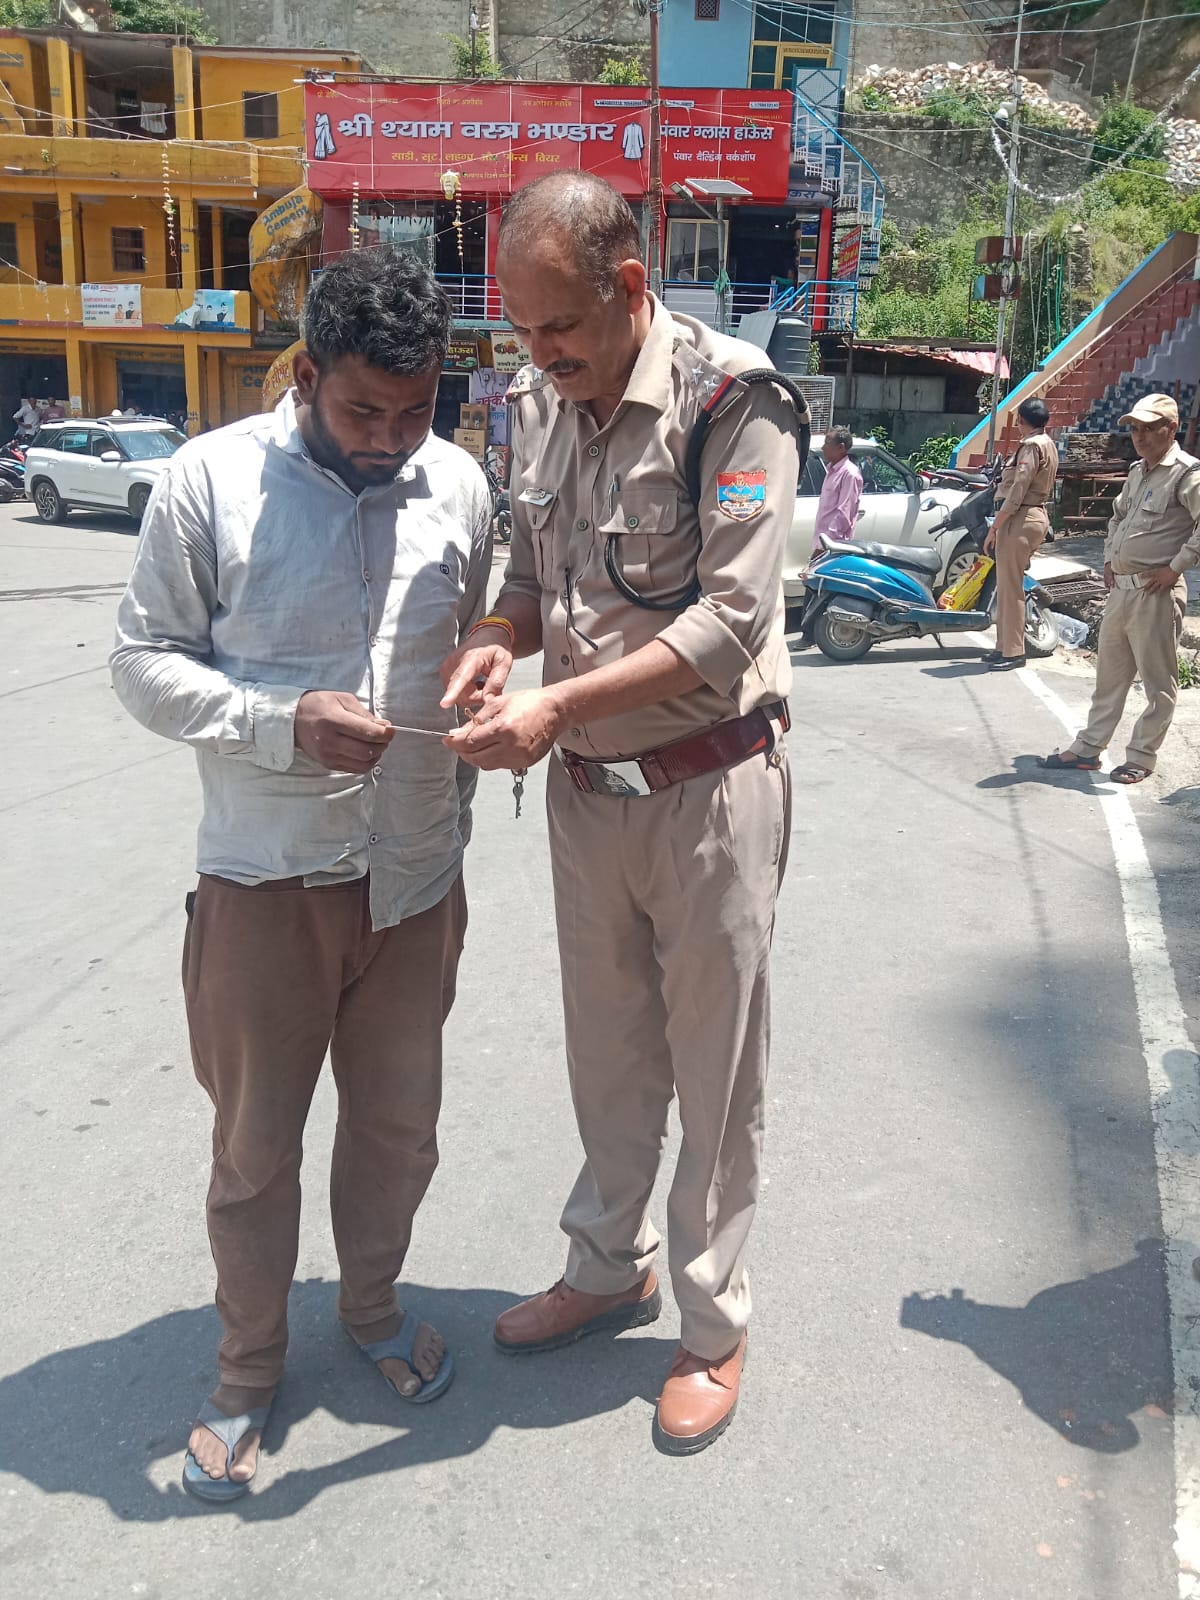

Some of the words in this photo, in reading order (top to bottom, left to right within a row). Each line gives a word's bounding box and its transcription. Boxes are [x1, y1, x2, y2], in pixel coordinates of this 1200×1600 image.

[336, 113, 375, 137] श्री
[381, 120, 453, 138] श्याम
[460, 121, 521, 139] वस्त्र
[527, 122, 617, 142] भण्डार
[693, 125, 732, 139] ग्लास
[535, 152, 560, 163] वियर
[262, 194, 304, 226] Ambuja
[266, 203, 310, 236] Cement
